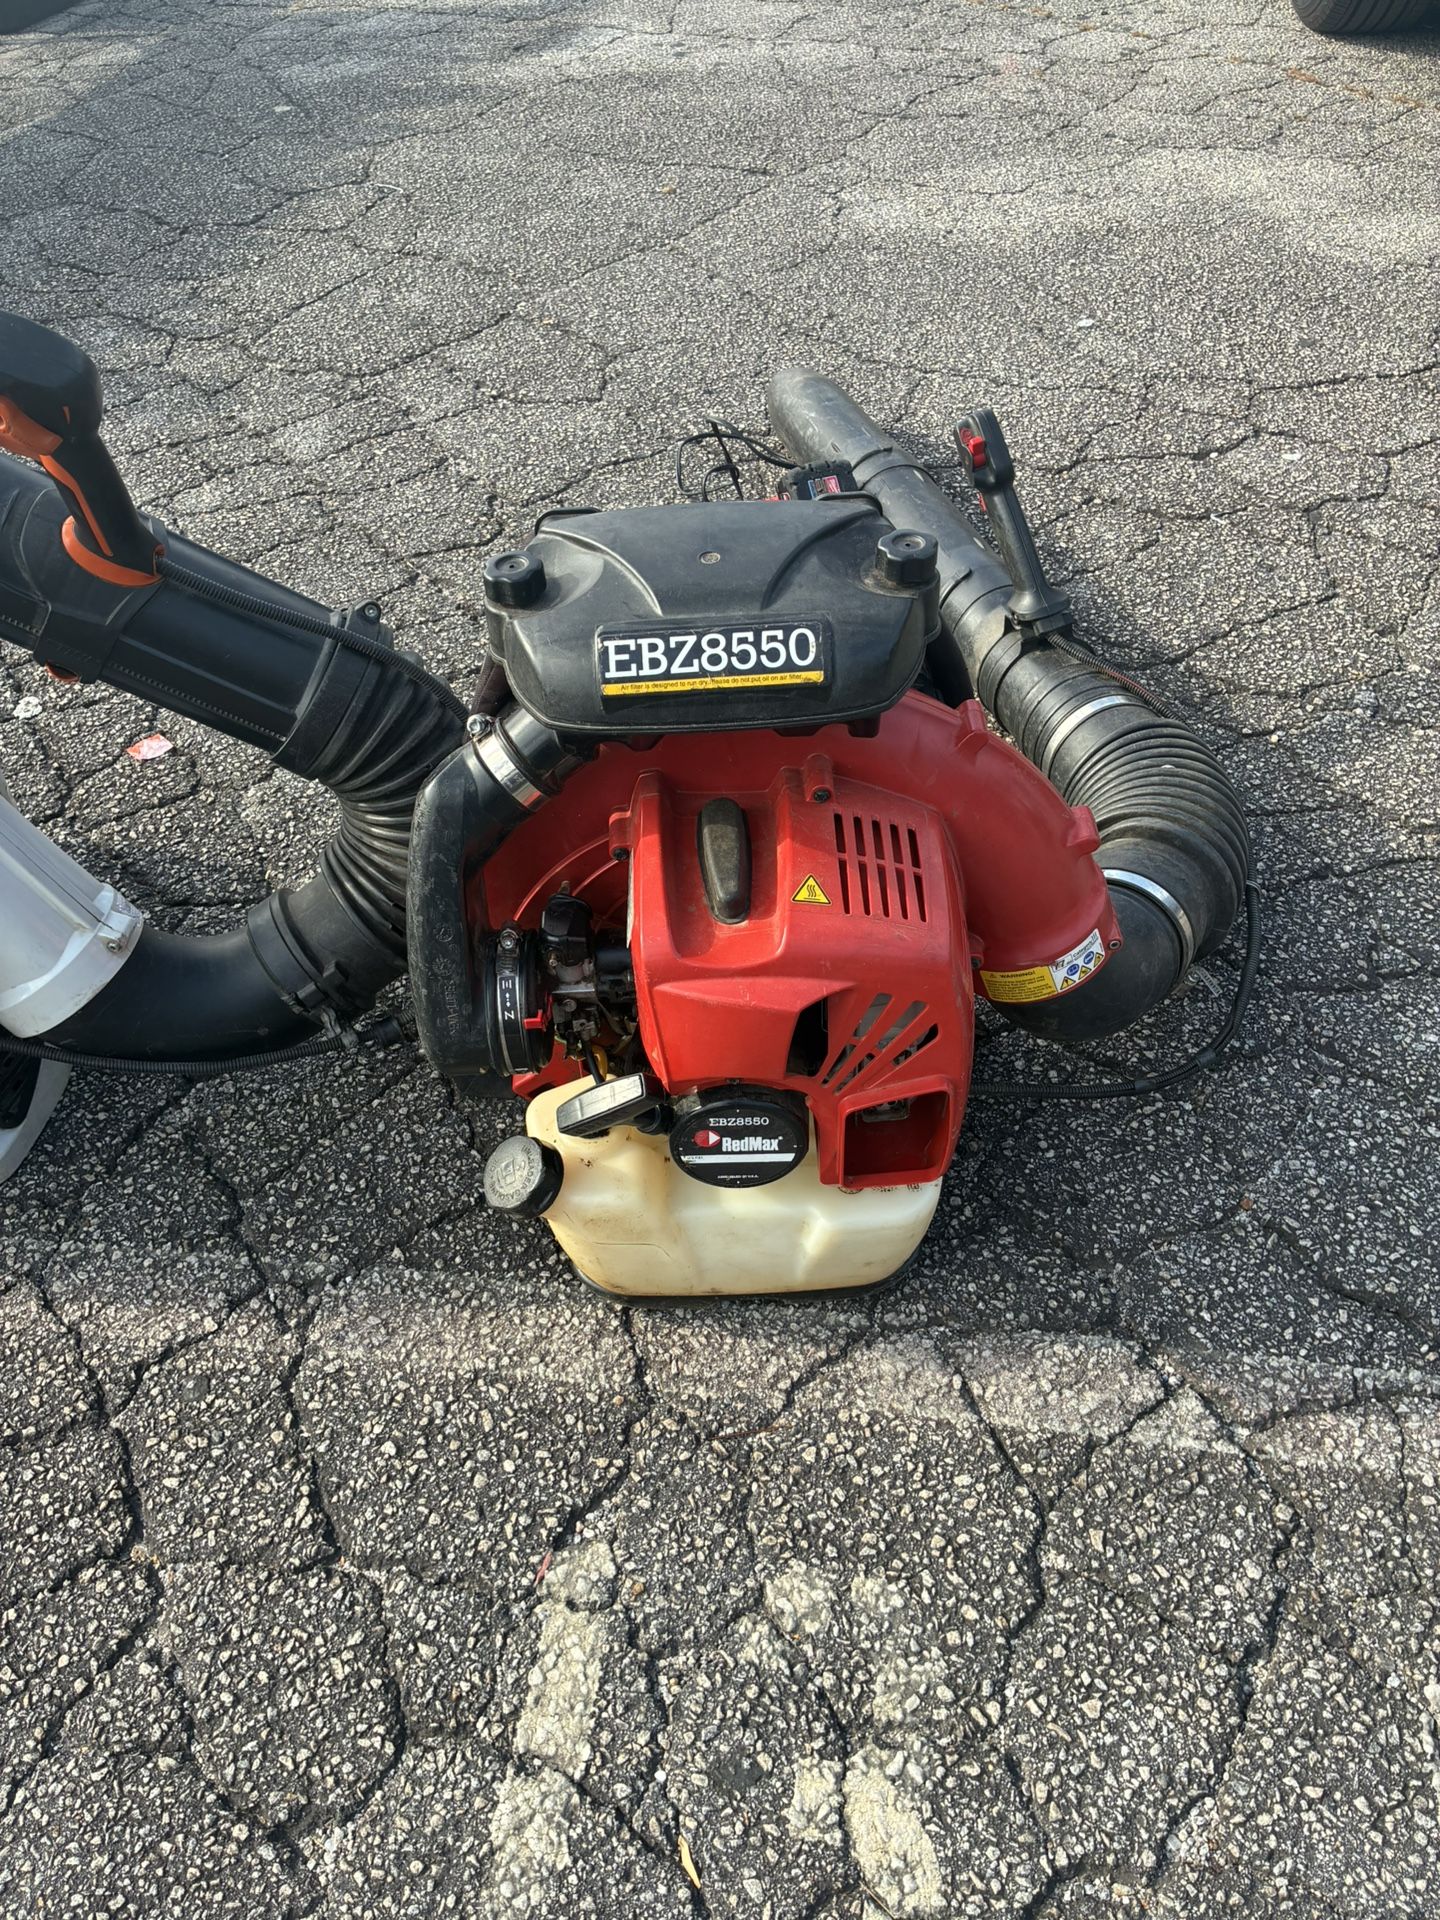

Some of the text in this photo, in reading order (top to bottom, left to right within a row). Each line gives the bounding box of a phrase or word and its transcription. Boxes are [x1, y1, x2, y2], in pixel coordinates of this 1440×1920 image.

[603, 628, 816, 678] EBZ8550
[652, 681, 679, 689] designed
[709, 1117, 770, 1126] EBZ8550
[489, 1180, 521, 1200] GASOLINE
